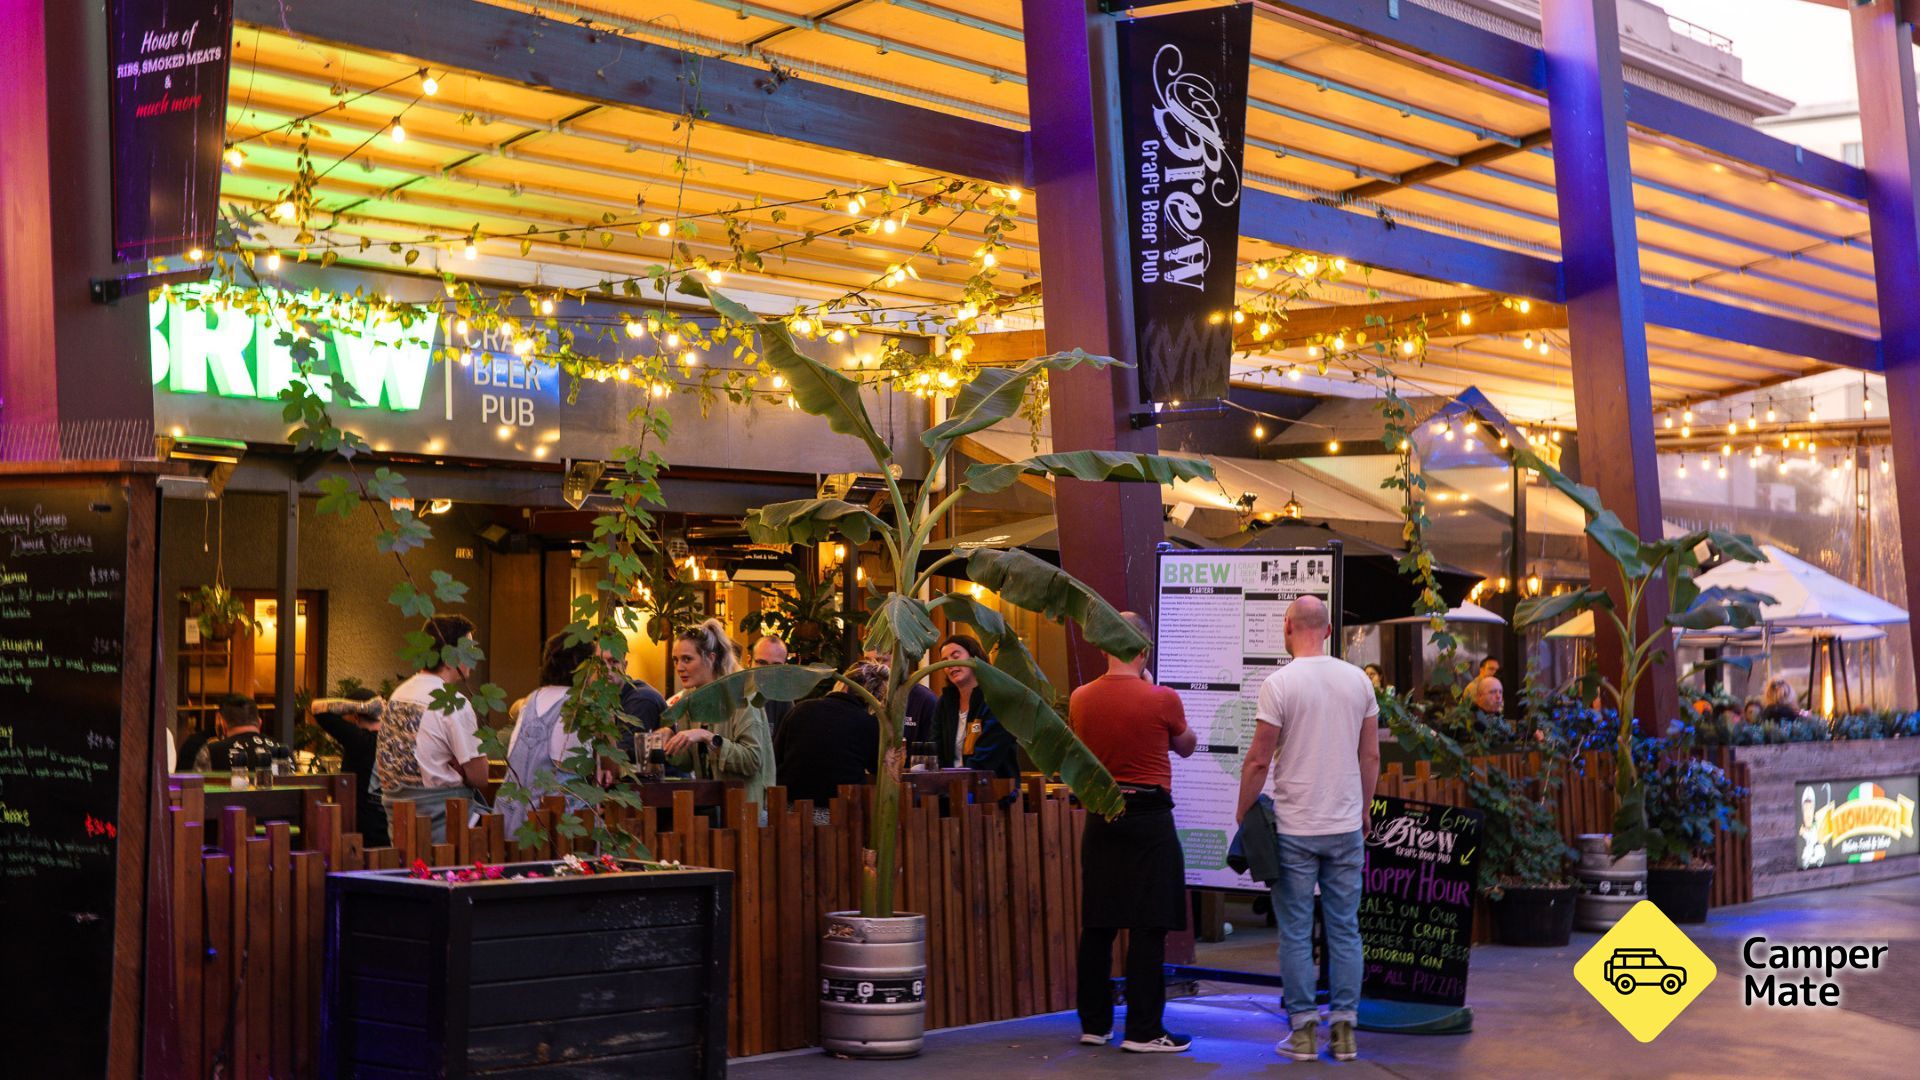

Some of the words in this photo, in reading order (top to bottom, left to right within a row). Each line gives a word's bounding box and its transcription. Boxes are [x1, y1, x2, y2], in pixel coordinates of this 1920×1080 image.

[141, 30, 179, 54] House
[182, 20, 200, 48] of
[117, 61, 141, 79] RIBS,
[142, 56, 185, 73] SMOKED
[186, 47, 222, 66] MEATS
[164, 76, 172, 89] &
[136, 91, 168, 118] much
[171, 94, 202, 112] more
[1141, 139, 1160, 199] Craft
[1152, 44, 1240, 292] Brew
[1141, 200, 1160, 245] Beer
[1141, 249, 1160, 284] Pub
[149, 284, 440, 411] REW
[473, 354, 542, 391] BEER
[482, 394, 535, 426] PUB
[1164, 563, 1231, 584] BREW
[1365, 815, 1459, 854] Brew
[1395, 846, 1418, 859] Craft
[1418, 849, 1437, 862] Beer
[1437, 851, 1452, 864] Pub
[1400, 904, 1420, 919] ON
[1412, 922, 1460, 944] CRAFT
[1363, 944, 1416, 965] ROTORUA
[1420, 953, 1444, 969] GIN
[1384, 969, 1407, 986] ALL
